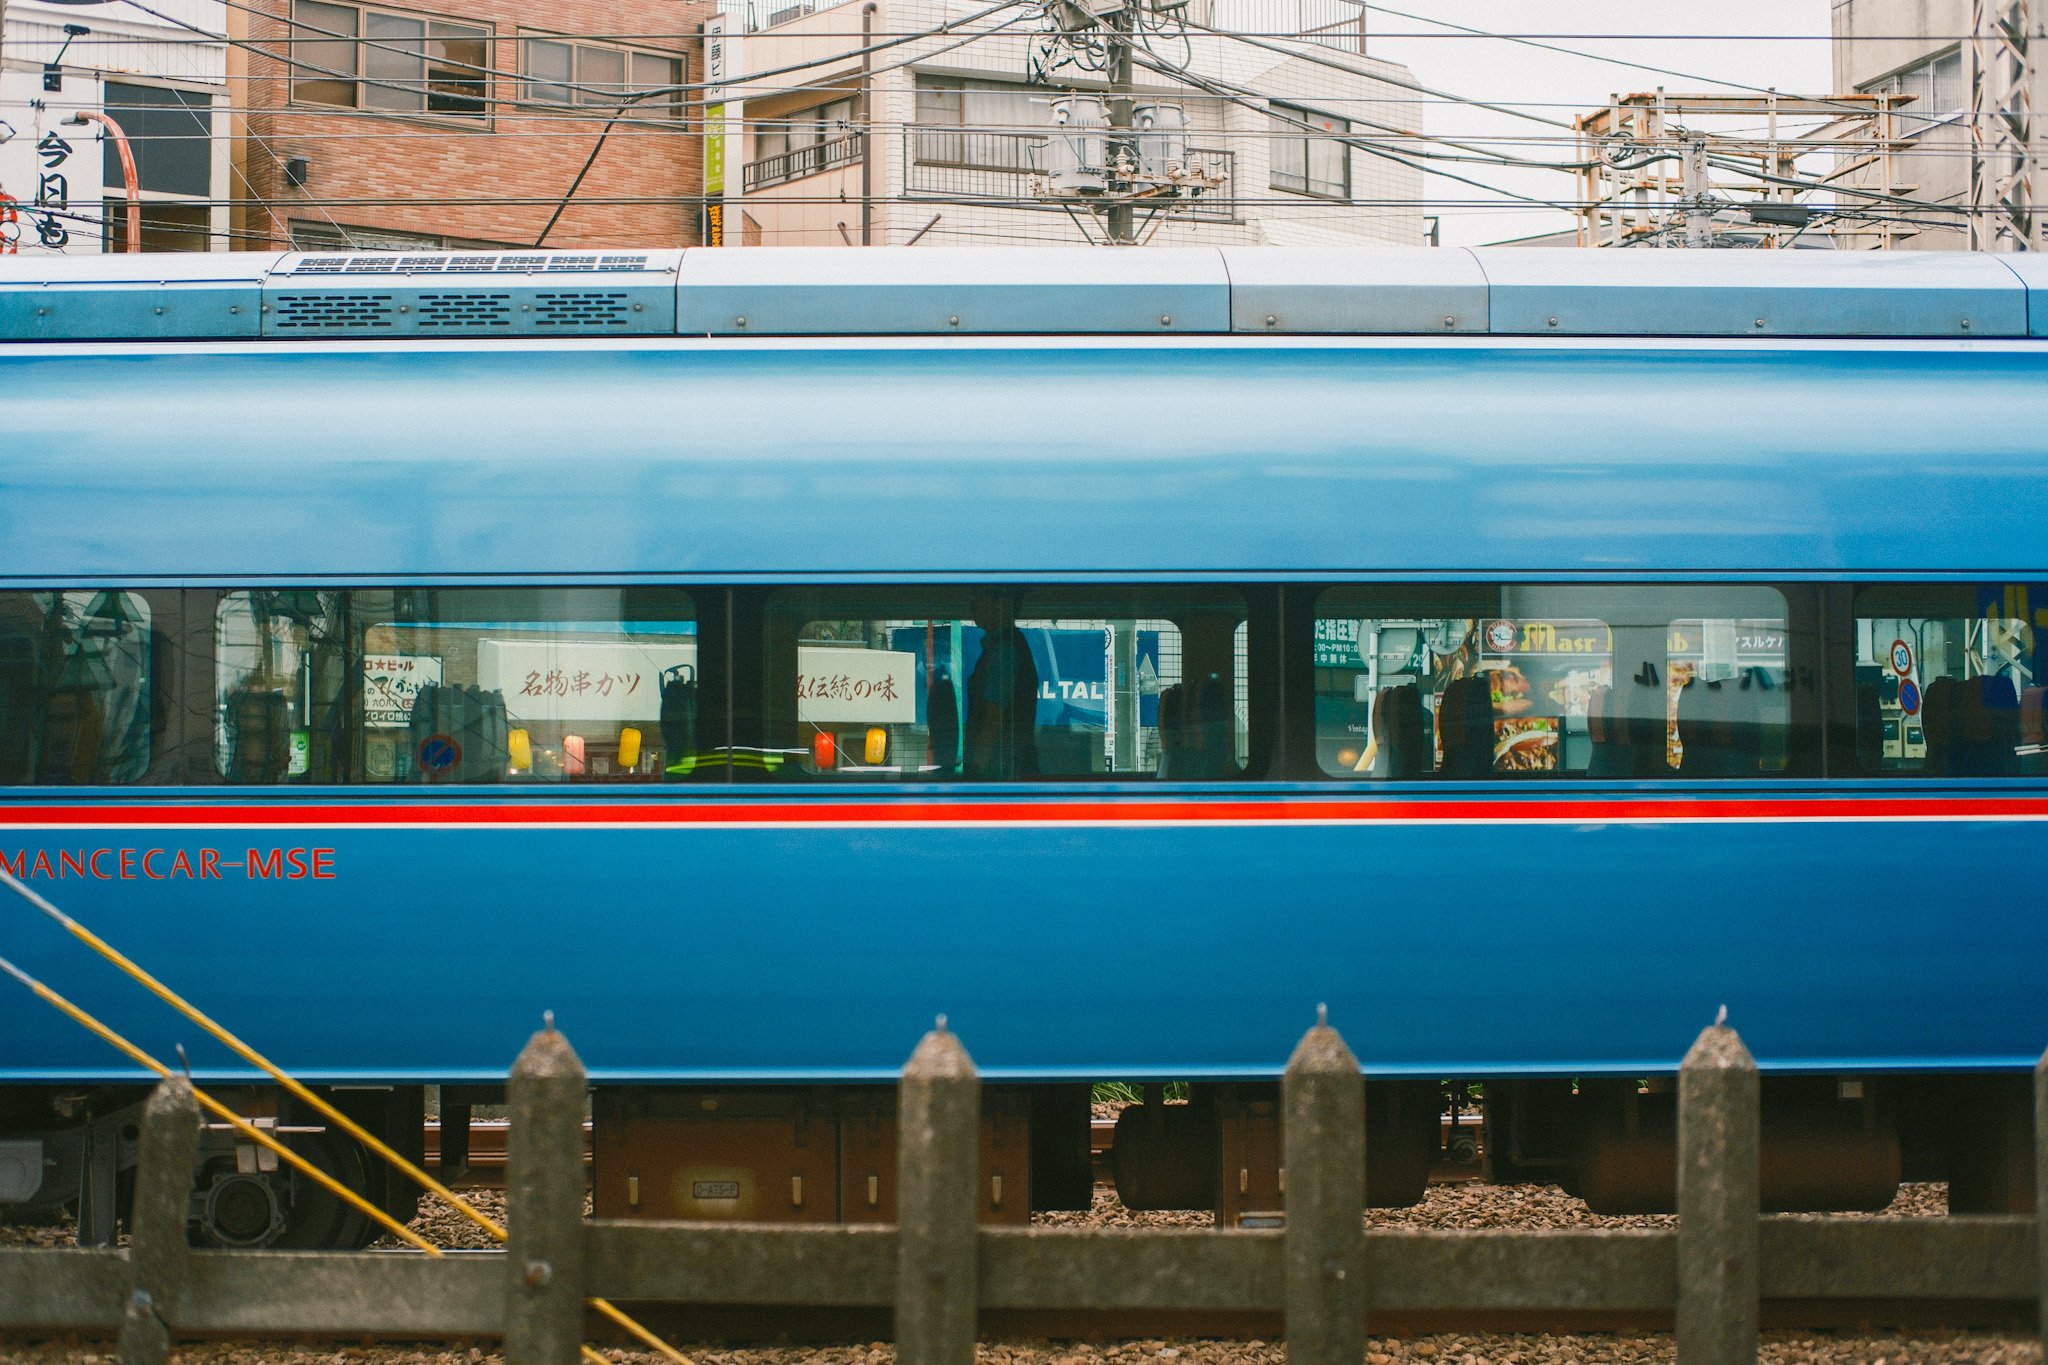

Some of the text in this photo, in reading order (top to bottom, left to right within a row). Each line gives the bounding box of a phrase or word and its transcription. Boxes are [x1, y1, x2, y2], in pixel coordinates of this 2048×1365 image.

[37, 130, 73, 248] 今日も
[1519, 621, 1597, 653] Masr
[1736, 635, 1784, 649] スルケ
[1895, 649, 1908, 667] 30
[519, 670, 641, 697] 名物串カツ
[1037, 681, 1104, 699] LTAL
